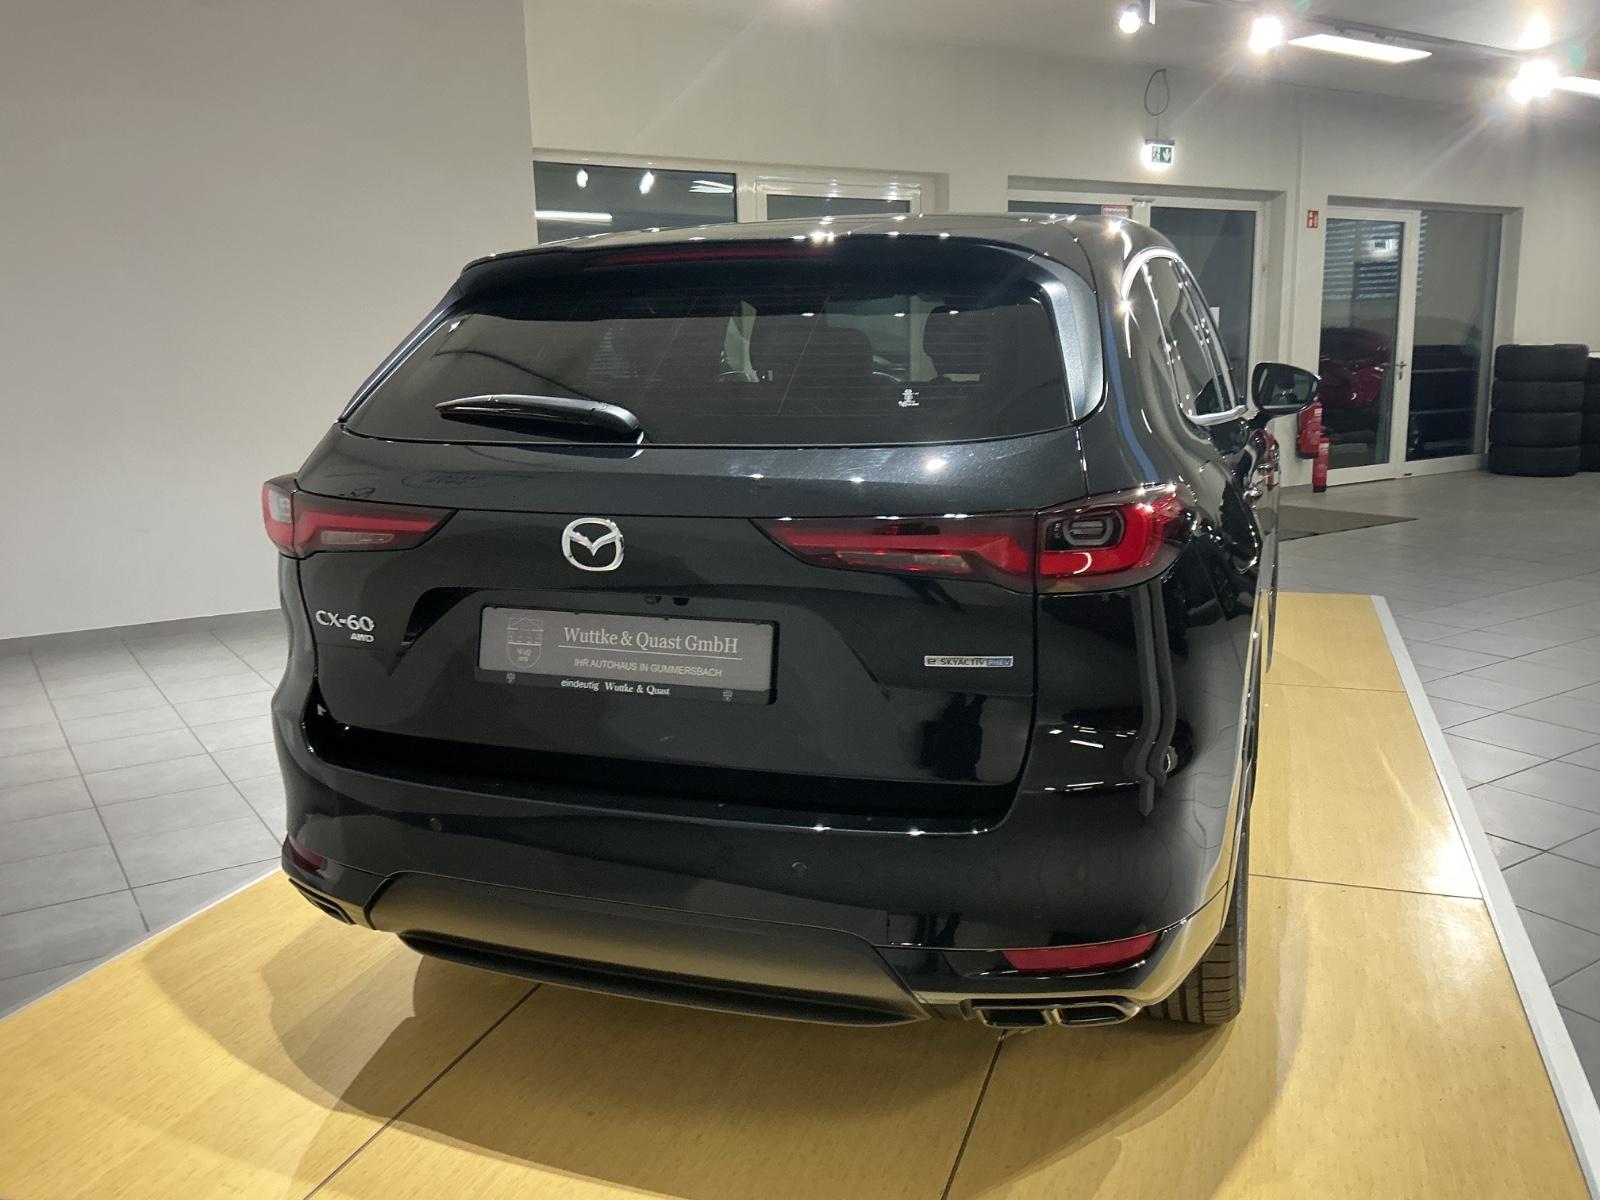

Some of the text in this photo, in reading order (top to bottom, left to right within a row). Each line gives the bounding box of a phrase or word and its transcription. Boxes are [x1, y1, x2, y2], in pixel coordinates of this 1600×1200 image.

[315, 610, 375, 632] CX-60
[350, 632, 375, 643] AWD
[564, 627, 738, 653] Wuttke & Quast GmbH
[574, 658, 723, 678] IHR AUTOHAUS IN GUMMERSBACH
[940, 657, 986, 666] SKYACTIV
[560, 678, 671, 696] eindeutig Wuttke & Quast
